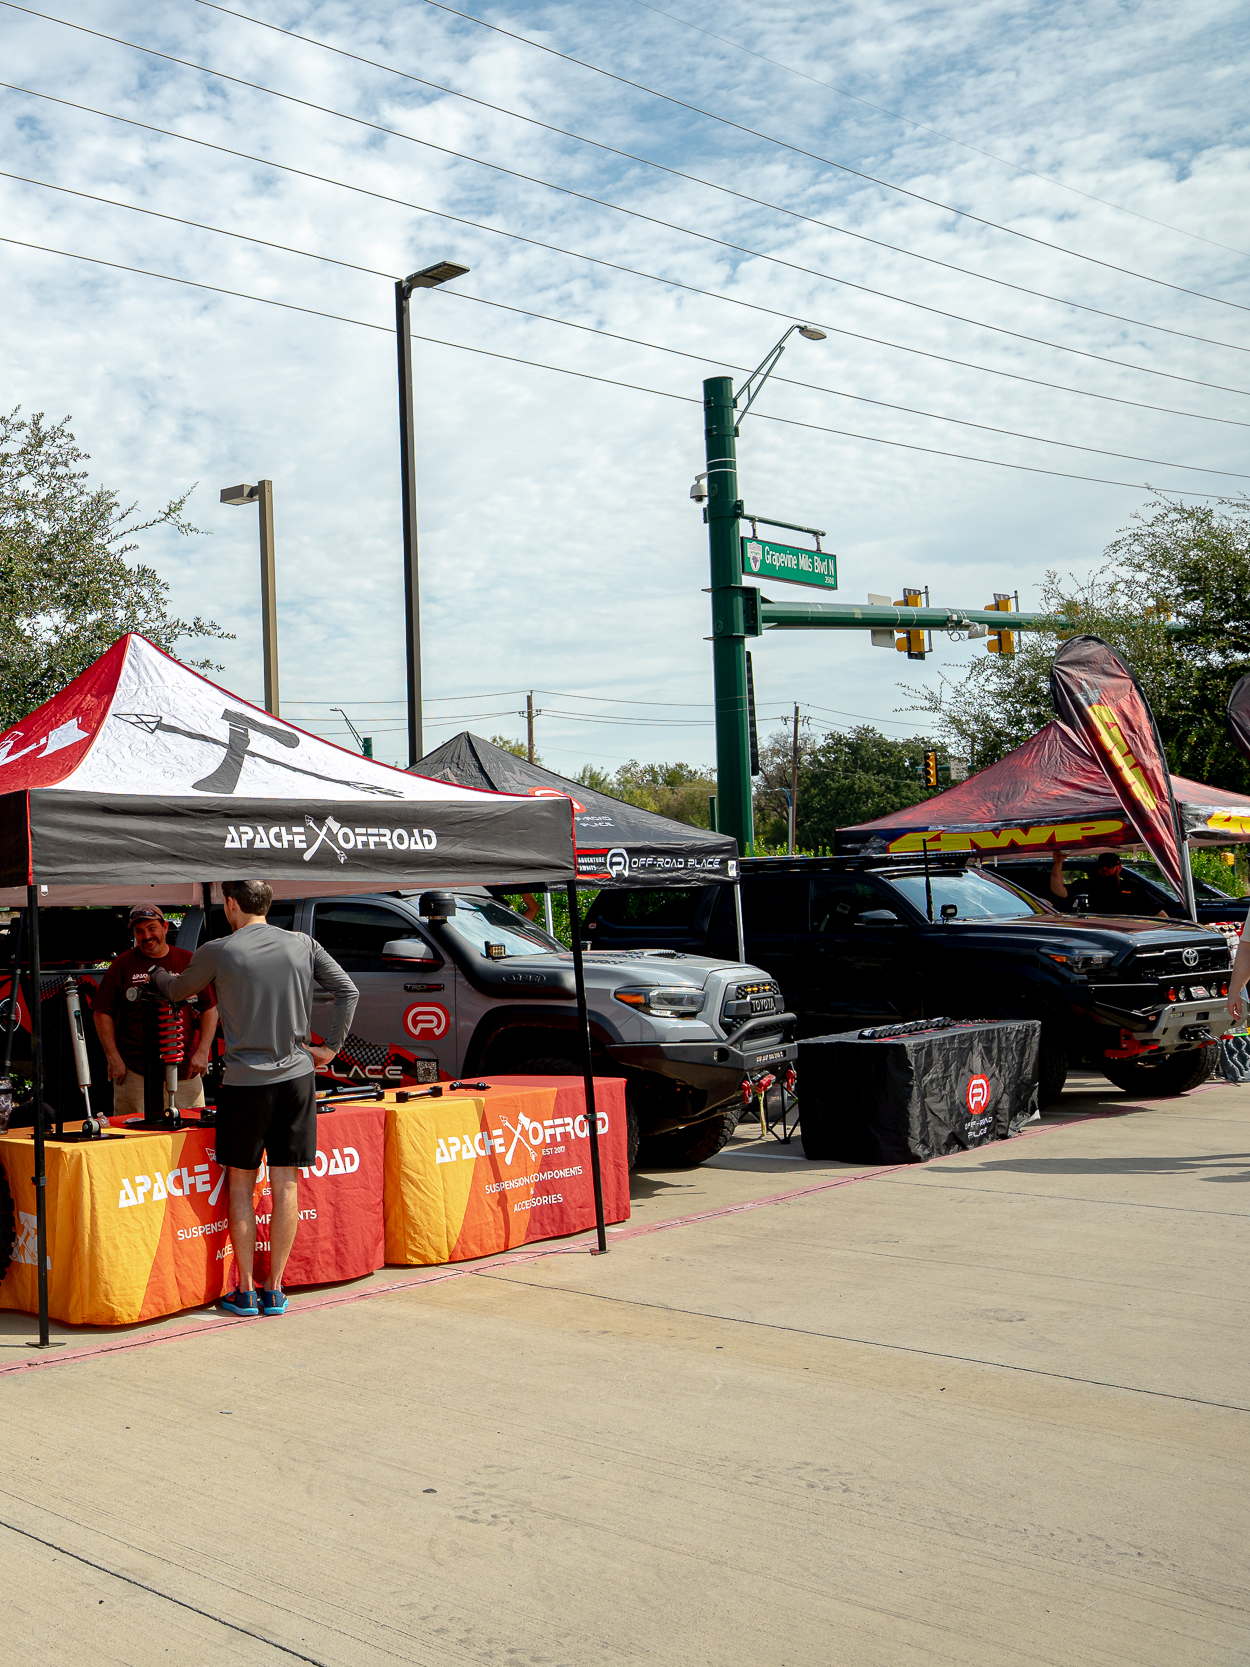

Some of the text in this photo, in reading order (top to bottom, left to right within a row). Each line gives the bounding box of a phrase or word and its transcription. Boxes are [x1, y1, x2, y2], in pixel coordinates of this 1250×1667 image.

[764, 546, 798, 570] Grapevine
[798, 553, 813, 572] Mills
[813, 556, 828, 575] Blvd
[828, 559, 835, 576] N
[224, 826, 437, 850] APACHE OFFROAD
[887, 819, 1126, 853] 4WP
[631, 858, 721, 868] OFF-ROAD PLACE
[752, 997, 775, 1013] TOYOTA
[314, 1064, 404, 1079] PLACE
[435, 1127, 507, 1165] APACHE
[542, 1148, 553, 1156] EST
[118, 1164, 210, 1209] APACHE
[485, 1165, 583, 1195] SUSPENSION COMPONENTS
[529, 1187, 535, 1195] &
[513, 1193, 563, 1213] ACCESSORIES
[177, 1219, 229, 1241] SUSPENSIO
